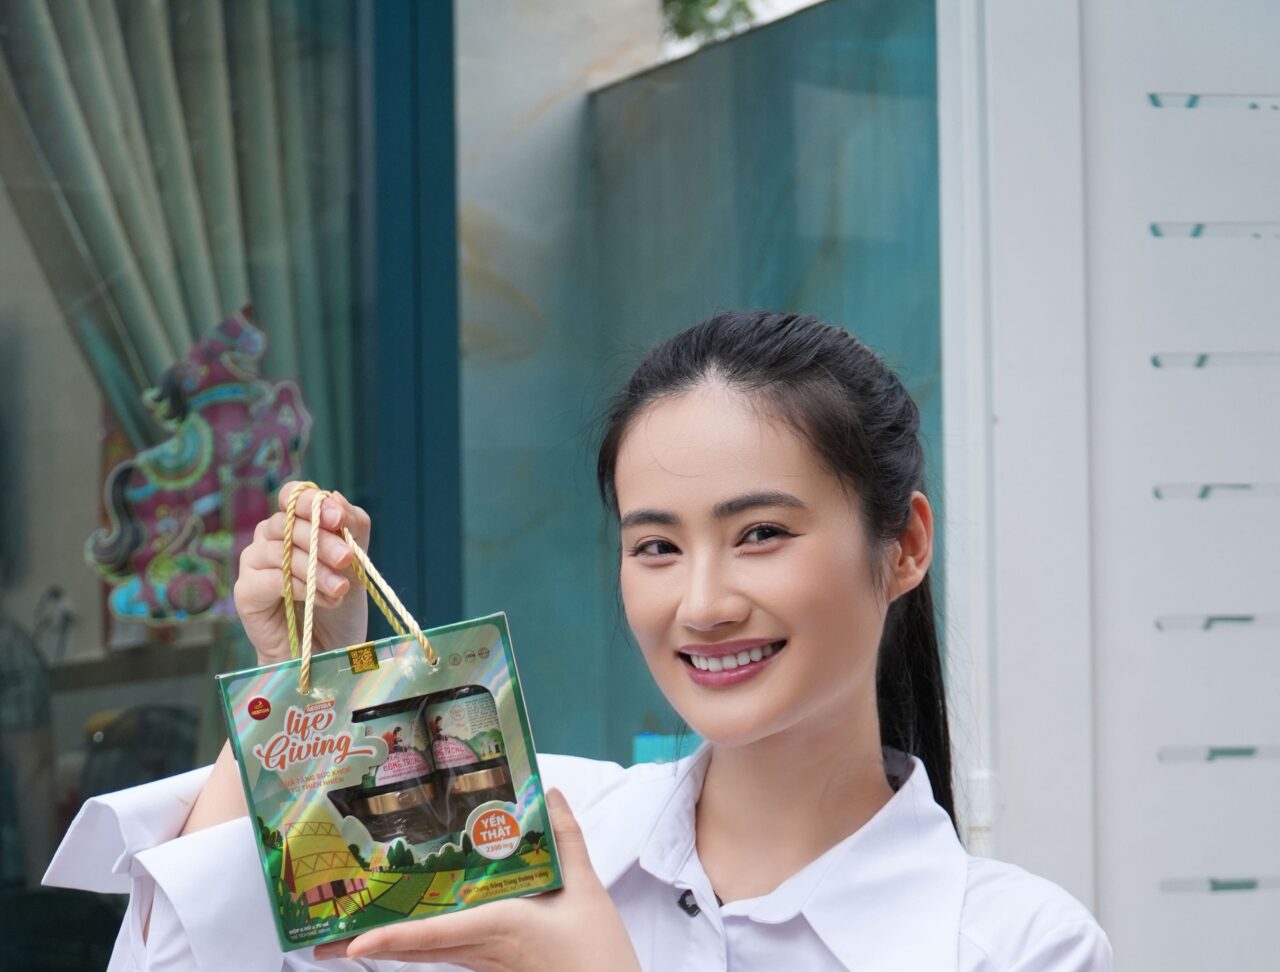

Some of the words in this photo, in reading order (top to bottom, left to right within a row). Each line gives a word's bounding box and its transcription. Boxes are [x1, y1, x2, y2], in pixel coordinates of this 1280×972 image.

[286, 710, 333, 741] life
[255, 735, 373, 770] Giving
[481, 813, 506, 829] YẾN
[480, 825, 511, 842] THẬT
